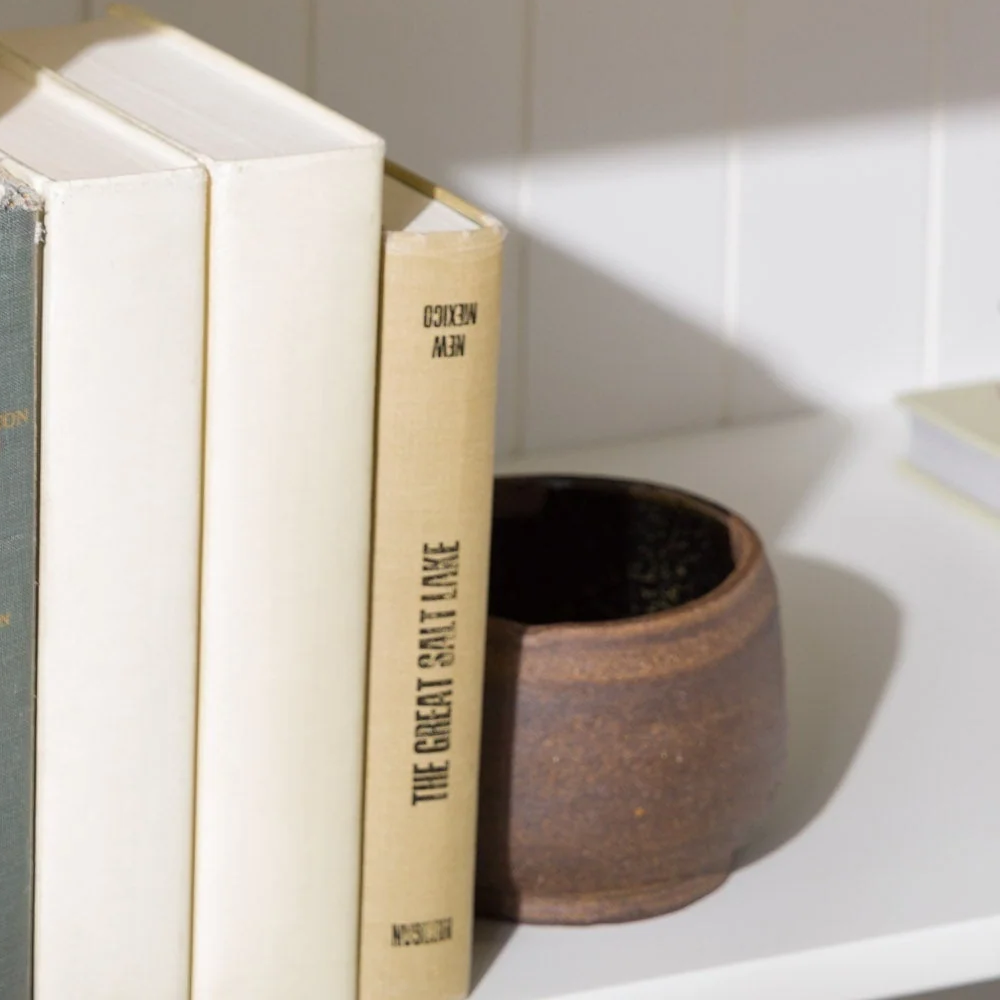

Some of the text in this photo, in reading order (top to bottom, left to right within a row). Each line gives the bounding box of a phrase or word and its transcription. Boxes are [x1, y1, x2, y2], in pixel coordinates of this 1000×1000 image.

[423, 302, 478, 328] MEXICO
[432, 334, 466, 359] NEW
[412, 540, 459, 806] THE GREAT SALT LAKE
